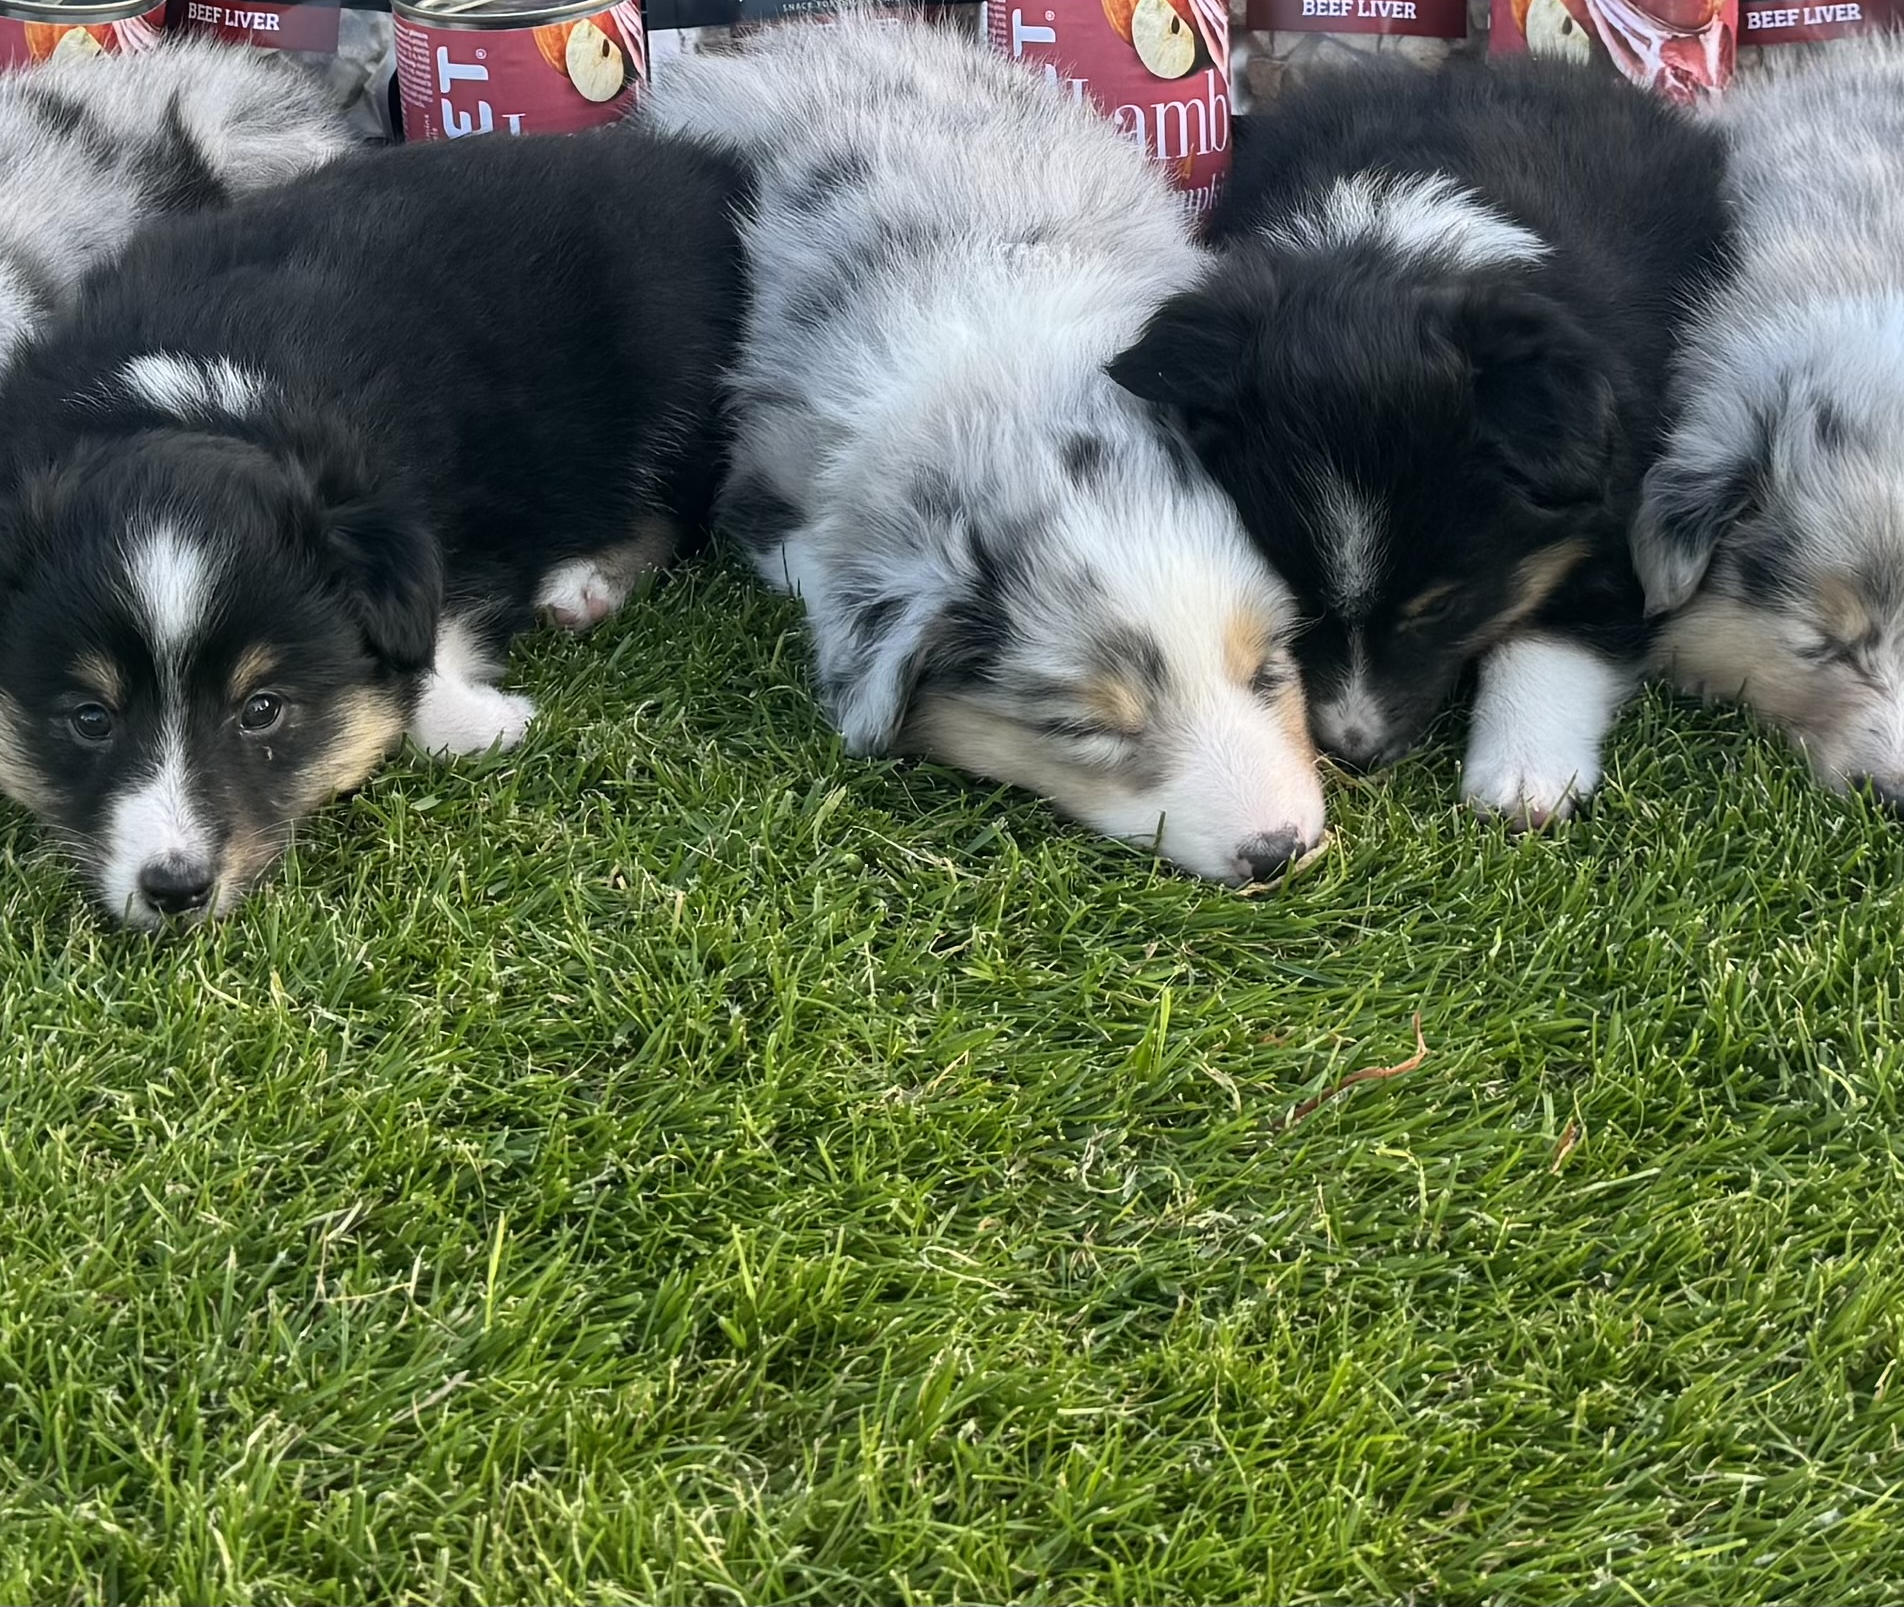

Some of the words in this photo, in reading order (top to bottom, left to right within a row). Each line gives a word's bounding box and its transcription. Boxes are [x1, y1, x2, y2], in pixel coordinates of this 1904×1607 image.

[188, 2, 221, 23] BEEF
[225, 9, 280, 31] LIVER
[1358, 0, 1417, 19] LIVER
[1747, 10, 1798, 29] BEEF
[1804, 3, 1862, 25] LIVER
